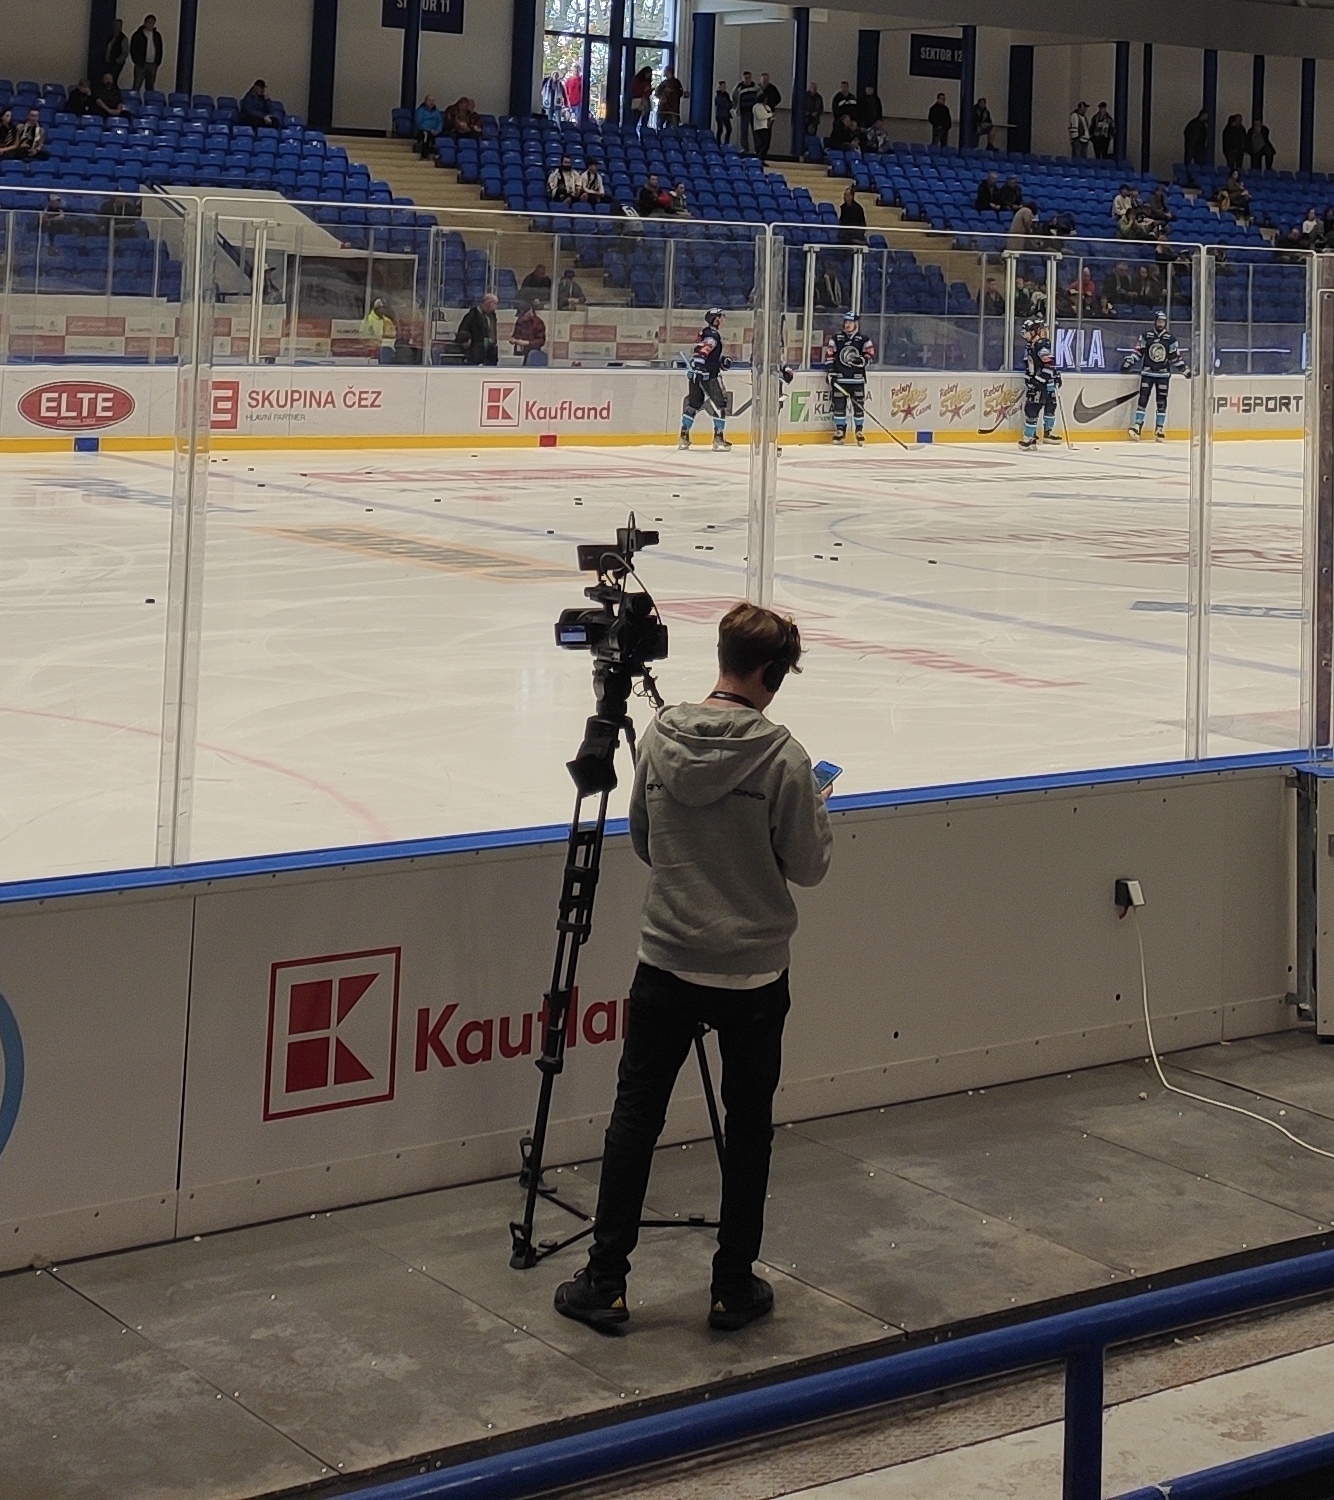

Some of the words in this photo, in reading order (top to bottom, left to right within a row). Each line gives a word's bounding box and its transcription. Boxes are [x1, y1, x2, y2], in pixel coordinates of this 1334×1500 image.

[440, 0, 450, 13] 11
[920, 46, 952, 62] SEKTOR
[1055, 329, 1106, 369] KLA
[40, 392, 115, 417] ELTE
[247, 389, 336, 409] SKUPINA
[342, 385, 383, 409] ČEZ
[273, 413, 306, 422] PARTNER
[525, 400, 612, 421] Kaufland
